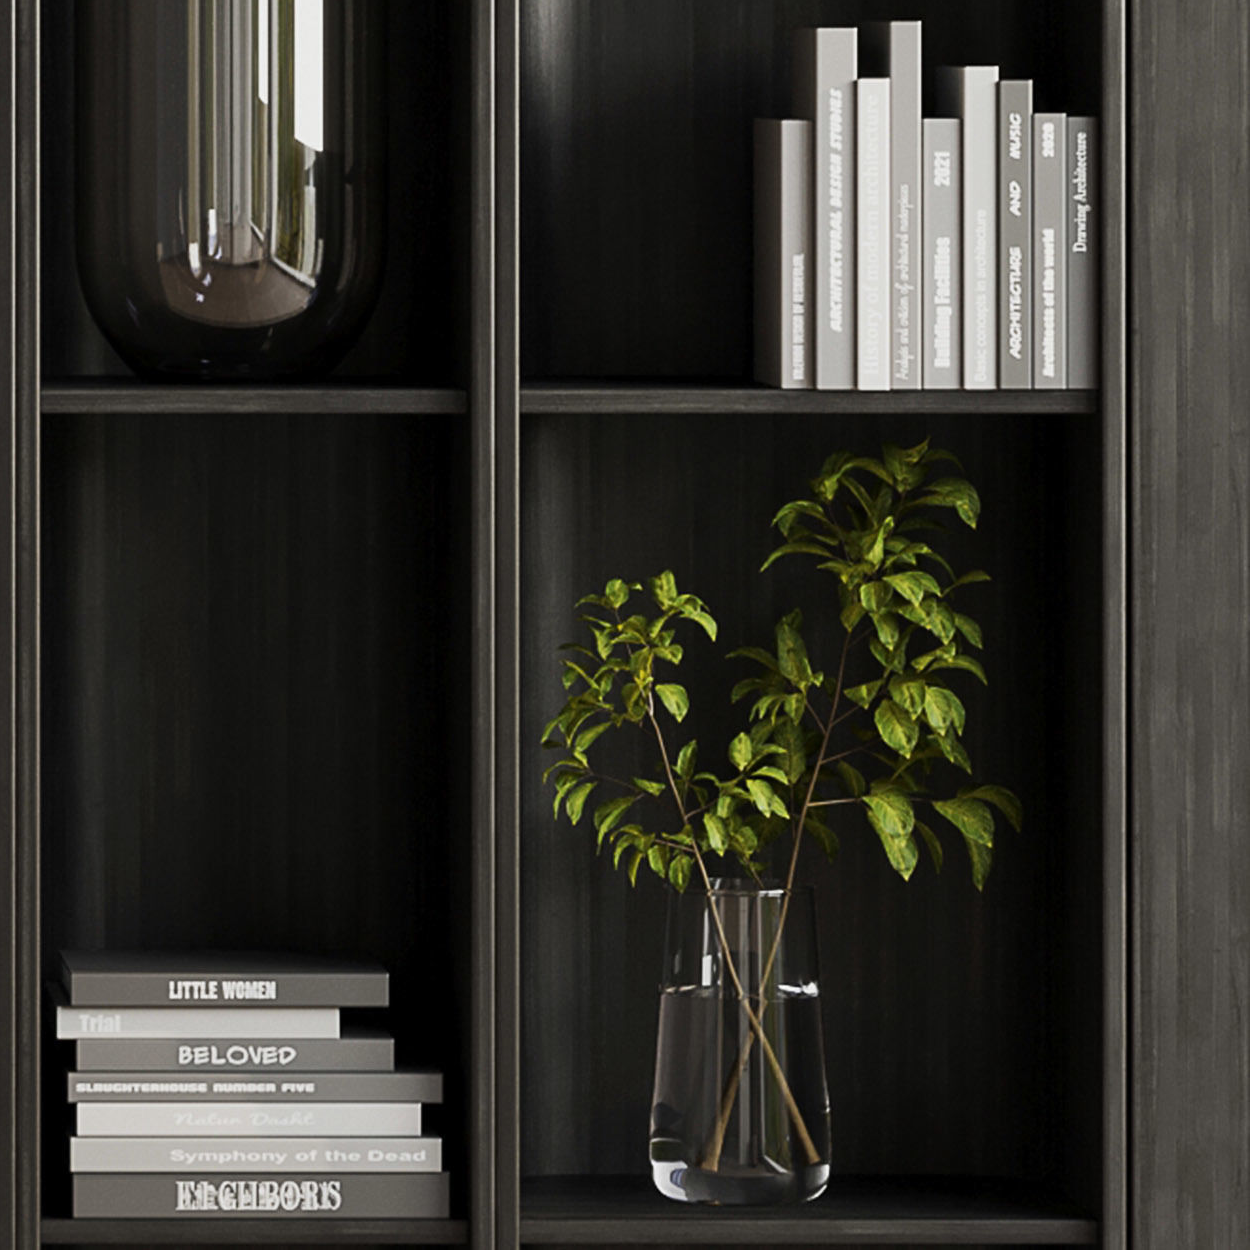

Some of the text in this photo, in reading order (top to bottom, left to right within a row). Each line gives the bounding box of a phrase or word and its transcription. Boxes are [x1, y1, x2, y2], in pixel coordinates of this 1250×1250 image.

[935, 151, 950, 187] 2021
[1074, 132, 1090, 252] Drawing Architecture
[863, 210, 879, 281] modern
[1010, 113, 1021, 359] ARCHITECTURE AND MUSIC
[862, 283, 879, 301] of
[863, 304, 881, 374] History
[169, 981, 276, 999] LITTLE WOMEN
[79, 1014, 121, 1032] Trial
[178, 1045, 297, 1065] BELOVED
[169, 1149, 426, 1164] Symphony of the Dead
